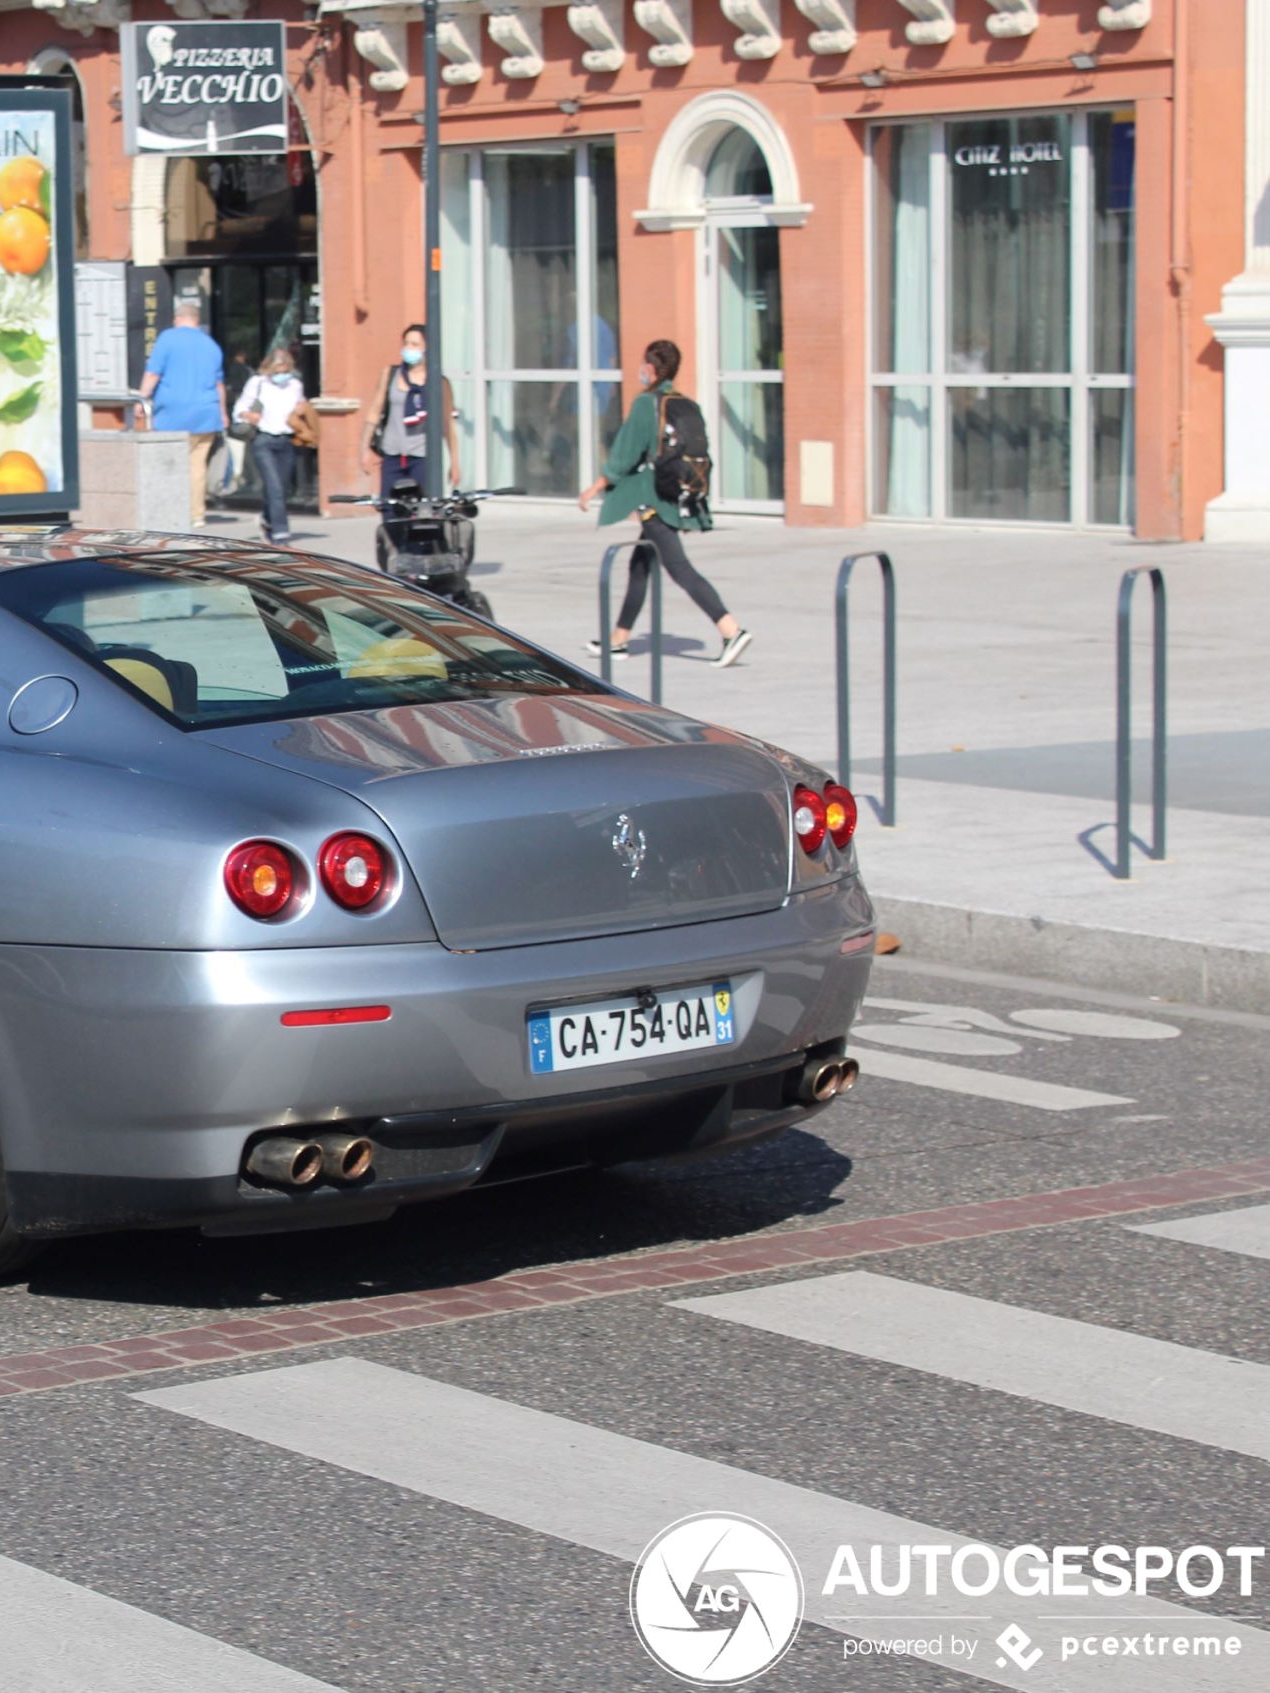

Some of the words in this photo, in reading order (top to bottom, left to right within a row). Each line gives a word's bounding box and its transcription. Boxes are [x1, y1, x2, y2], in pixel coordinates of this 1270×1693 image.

[173, 47, 275, 70] PIZZERIA
[136, 70, 284, 104] VECCHIO
[1009, 142, 1064, 163] HOTEL
[717, 1019, 732, 1040] 31
[538, 1050, 546, 1063] F
